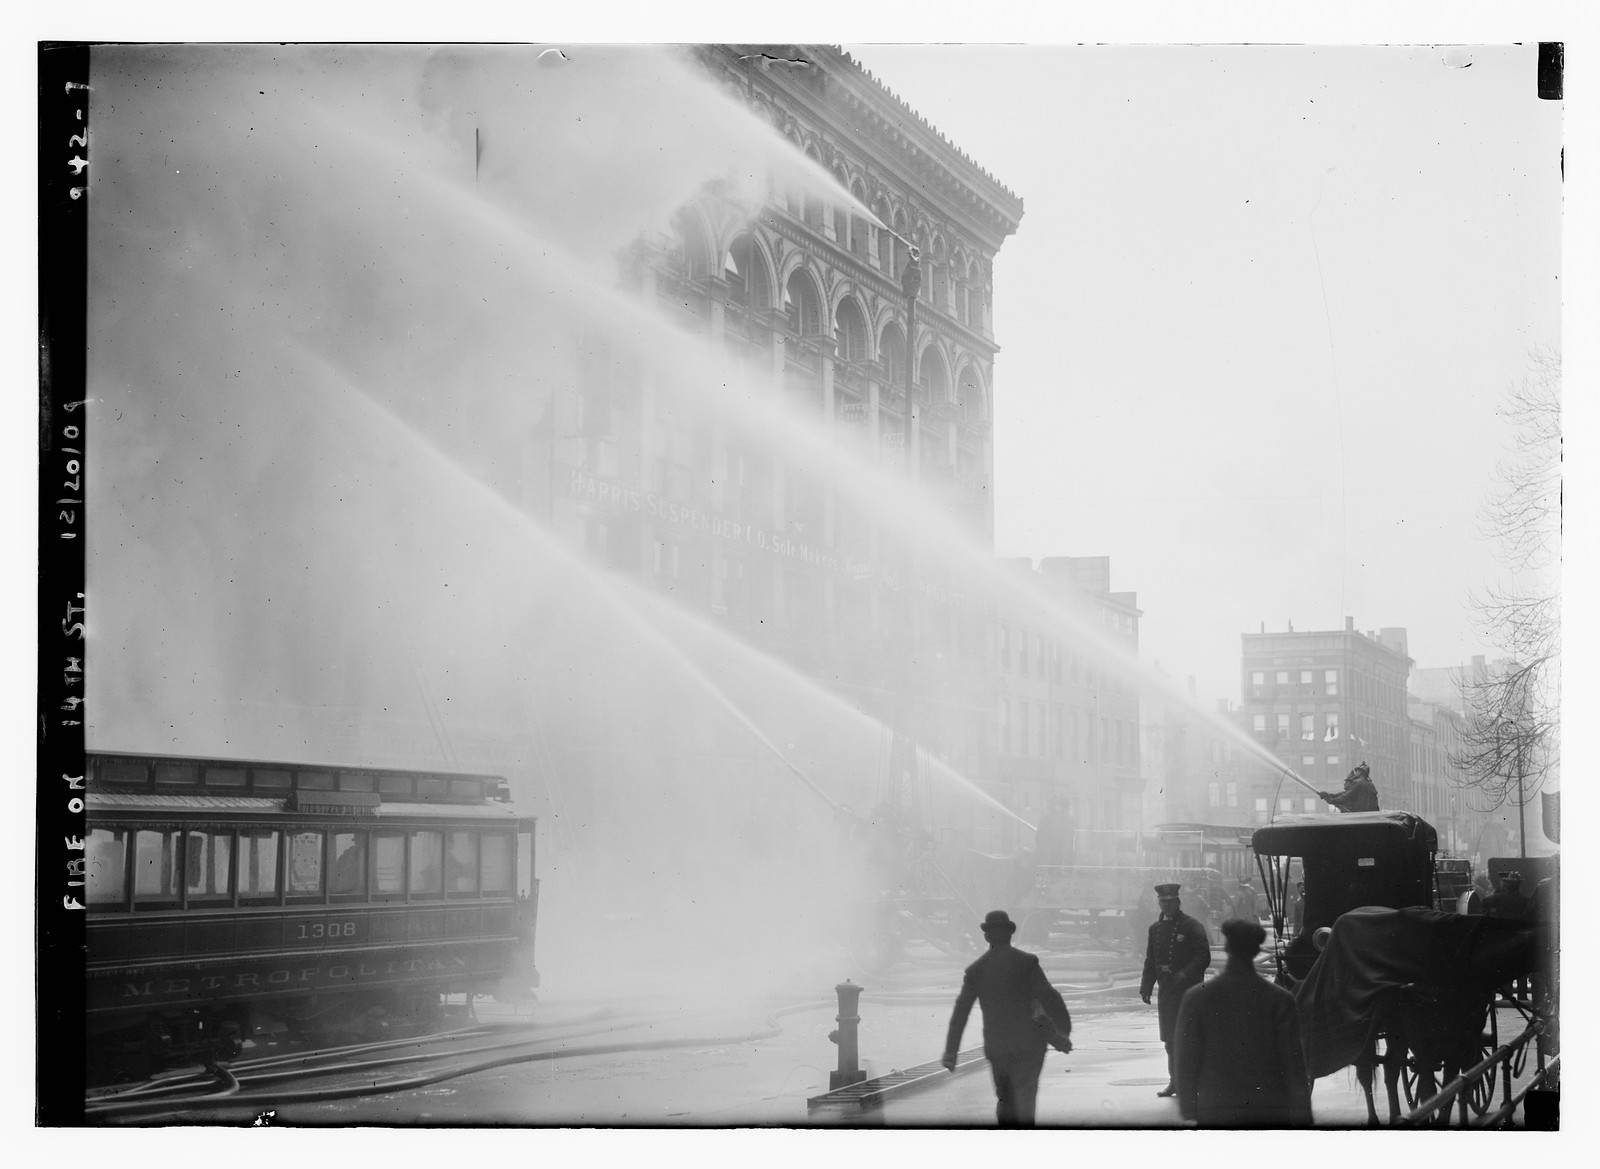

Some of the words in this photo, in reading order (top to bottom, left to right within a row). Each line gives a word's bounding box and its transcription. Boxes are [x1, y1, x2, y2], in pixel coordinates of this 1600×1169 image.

[569, 470, 641, 513] HARRIS
[646, 493, 742, 541] SUSPENDER
[296, 921, 356, 940] 1308
[120, 955, 469, 998] METROPOLITAN
